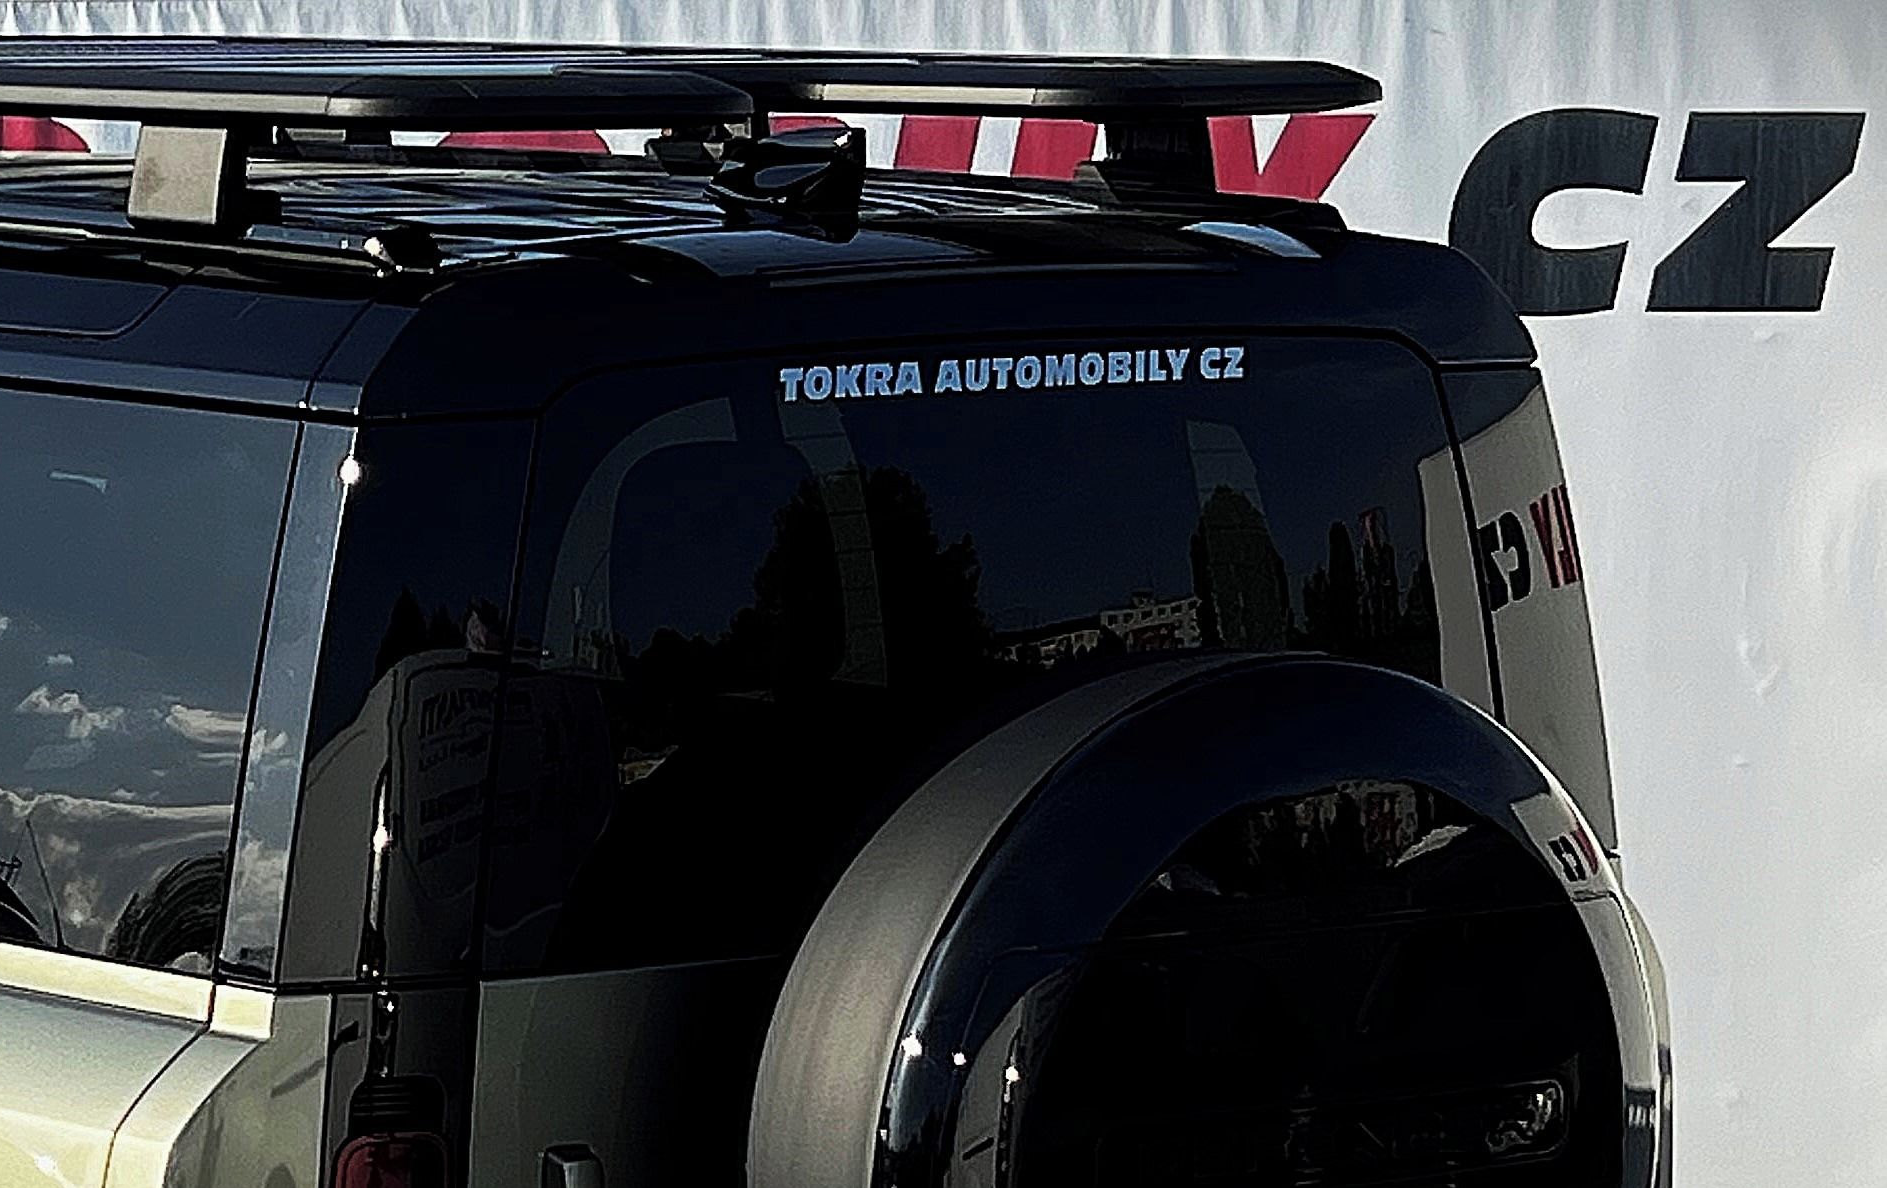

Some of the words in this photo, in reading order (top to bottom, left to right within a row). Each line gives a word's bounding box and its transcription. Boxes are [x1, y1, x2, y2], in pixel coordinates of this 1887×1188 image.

[1448, 107, 1867, 317] CZ
[779, 361, 923, 402] TOKRA
[934, 347, 1191, 394] AUTOMOBILY
[1199, 346, 1245, 380] CZ
